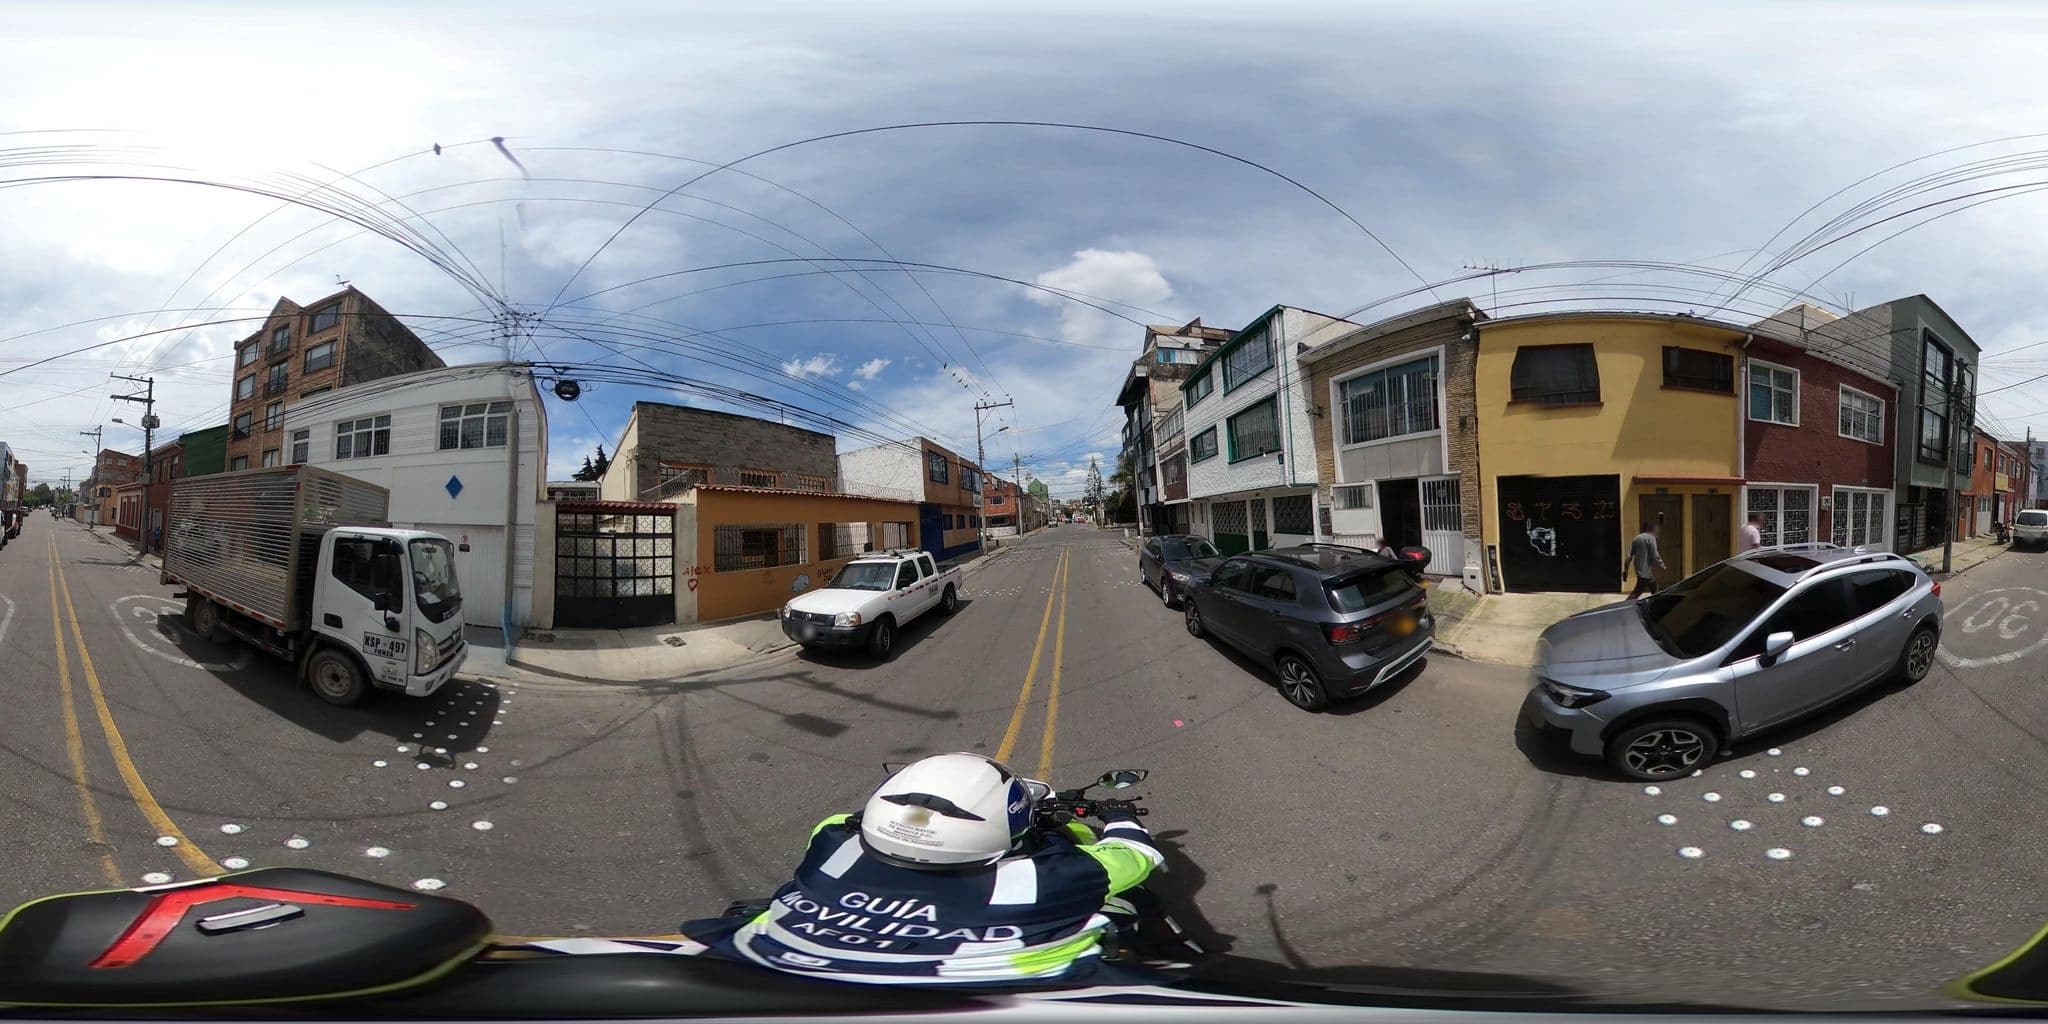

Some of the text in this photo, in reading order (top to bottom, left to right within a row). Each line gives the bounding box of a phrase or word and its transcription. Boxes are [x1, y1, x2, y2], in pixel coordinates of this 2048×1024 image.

[364, 636, 381, 648] KSP
[389, 641, 406, 654] 497
[780, 890, 1025, 942] MOVILIDAD
[839, 891, 937, 922] GUÍA
[791, 922, 893, 950] AF01
